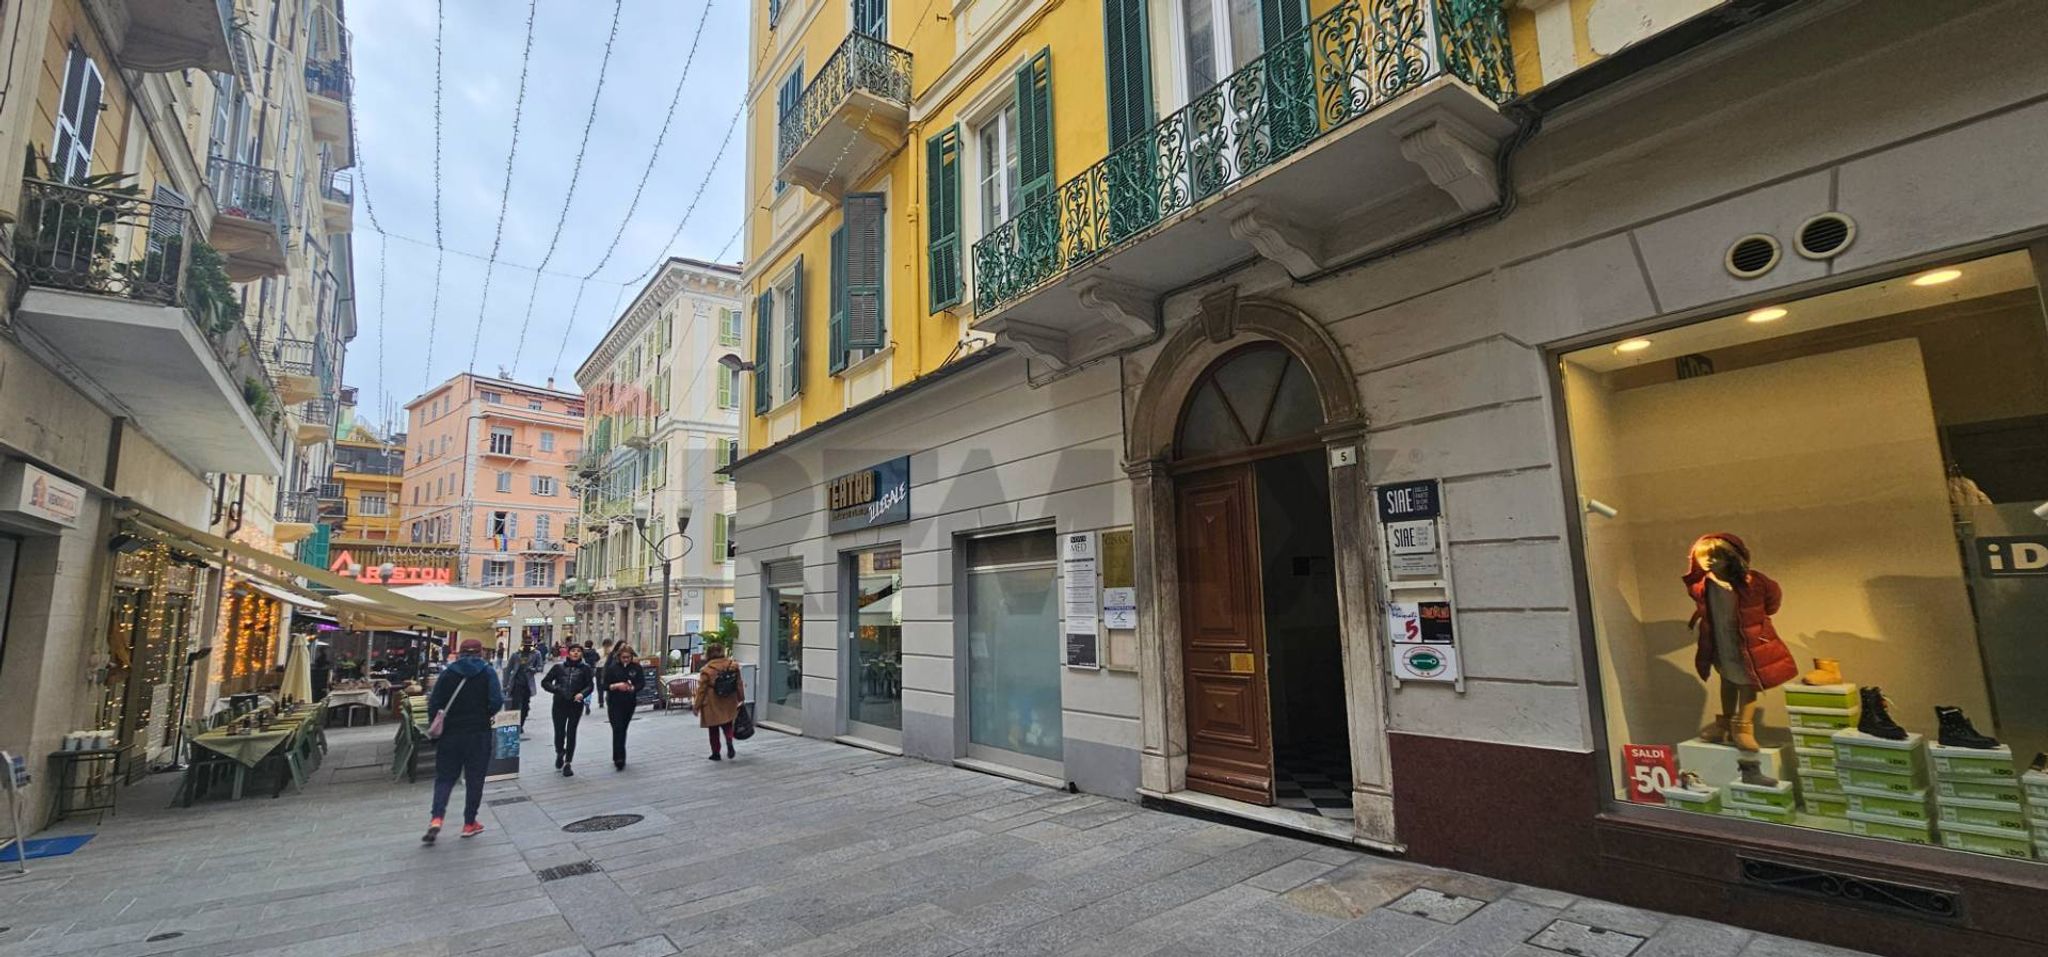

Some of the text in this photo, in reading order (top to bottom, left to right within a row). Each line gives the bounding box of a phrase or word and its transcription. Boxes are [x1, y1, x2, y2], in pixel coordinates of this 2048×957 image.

[1341, 452, 1347, 461] 5
[825, 472, 872, 510] TEATRO
[1387, 488, 1414, 514] SIAE
[1394, 528, 1416, 547] SIAE
[329, 550, 450, 580] ARSTON
[1406, 618, 1419, 640] 5
[1632, 749, 1664, 758] SALDI
